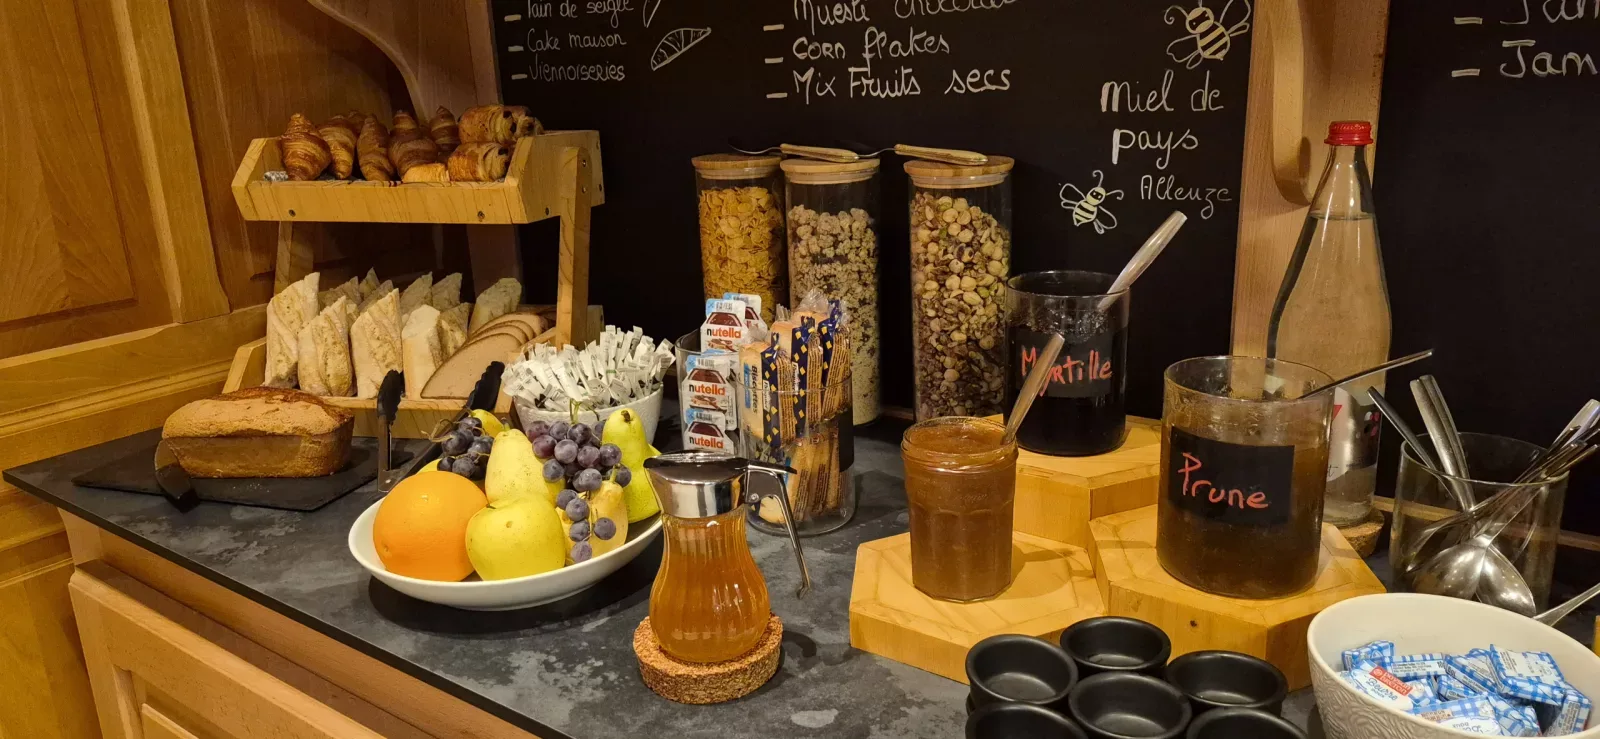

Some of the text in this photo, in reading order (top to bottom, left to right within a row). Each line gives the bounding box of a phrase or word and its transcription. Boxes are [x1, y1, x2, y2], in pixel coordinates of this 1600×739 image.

[560, 0, 578, 18] de
[527, 28, 627, 51] Cake maison
[792, 65, 1010, 104] Mix Fruits secs
[1100, 69, 1224, 112] Miel de
[1111, 128, 1199, 170] pays
[1140, 174, 1233, 220] Alleuze
[706, 327, 742, 339] nutella
[688, 384, 726, 396] nutella
[689, 436, 724, 449] nutella
[1177, 451, 1269, 509] Prune
